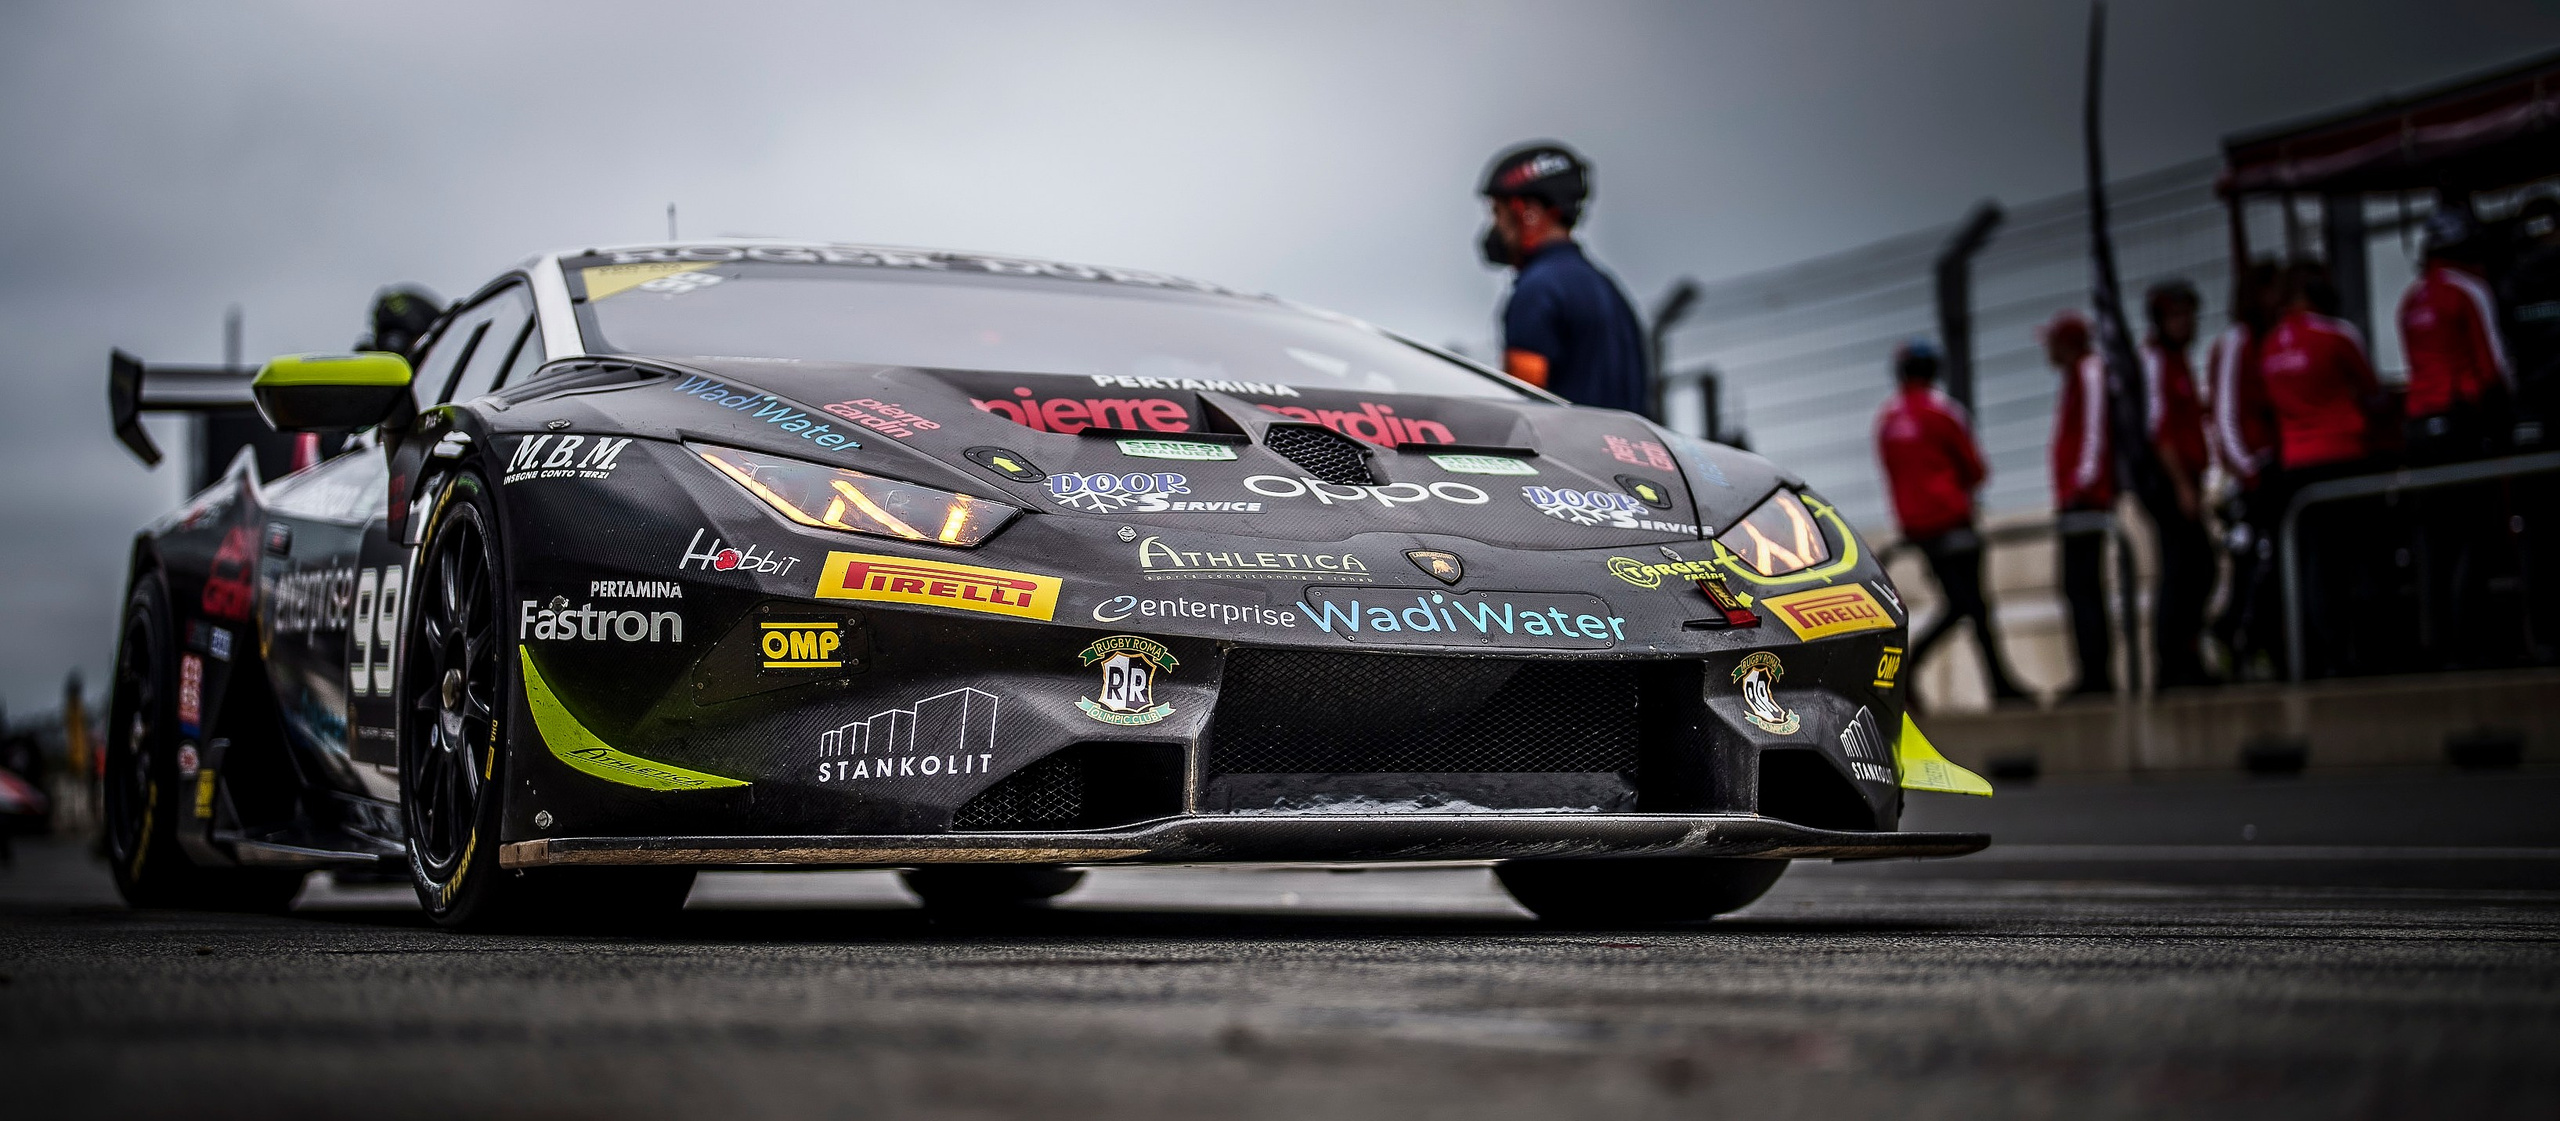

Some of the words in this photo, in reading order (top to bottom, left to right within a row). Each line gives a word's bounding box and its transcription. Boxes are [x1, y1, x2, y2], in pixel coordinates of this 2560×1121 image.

[1090, 374, 1300, 398] PERTAMINA
[672, 375, 862, 451] WadiWater
[1125, 441, 1223, 453] SENESI
[503, 470, 538, 485] INSEGNE
[540, 470, 576, 478] CONTO
[579, 471, 610, 479] TERZI
[1046, 472, 1191, 495] DOOR
[1243, 475, 1490, 507] oppo
[1132, 493, 1262, 513] SERVICE
[1138, 536, 1367, 571] ATHLETICA
[590, 580, 683, 599] PERTAMINA
[842, 561, 1037, 608] PIRELLI
[1684, 571, 1727, 581] racing
[520, 600, 683, 643] Fastron
[1140, 597, 1296, 628] enterprise
[1296, 594, 1625, 640] WadiWater
[1782, 592, 1879, 629] PIRELLI
[350, 565, 402, 696] 99
[762, 630, 839, 660] OMP
[1095, 638, 1132, 653] RUGBY
[1132, 638, 1162, 658] ROMA
[1877, 653, 1900, 679] OMP
[1091, 707, 1131, 724] OLIMPIC
[1132, 712, 1159, 724] CLUB
[819, 754, 993, 783] STANKOLIT
